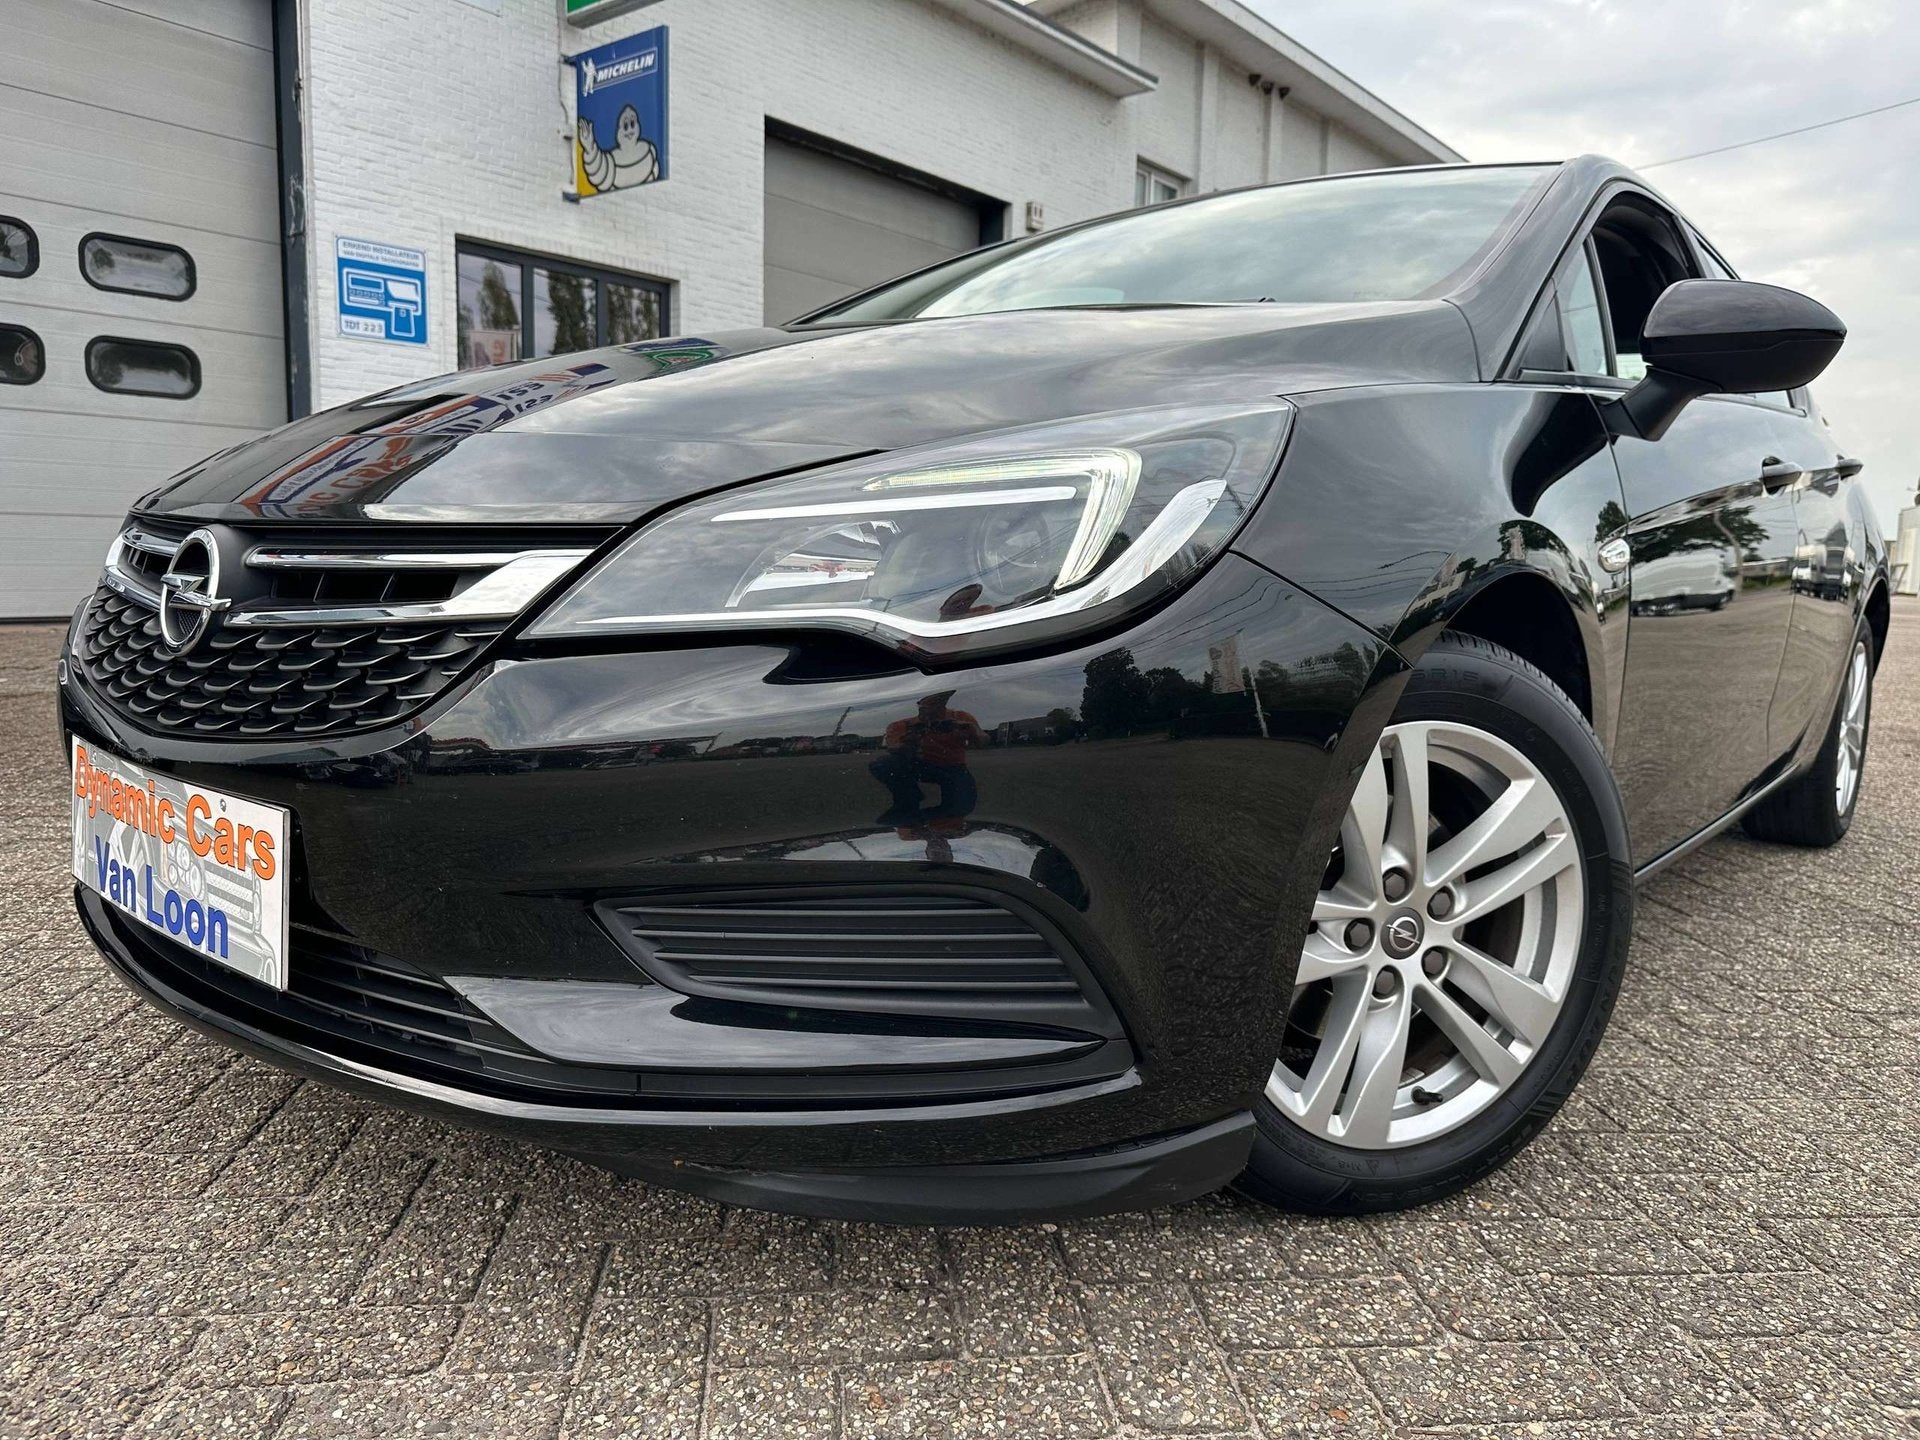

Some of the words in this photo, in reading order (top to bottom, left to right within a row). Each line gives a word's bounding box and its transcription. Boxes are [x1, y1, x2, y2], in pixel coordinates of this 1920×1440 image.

[597, 53, 655, 83] MICHELIN
[364, 322, 383, 334] 223
[76, 744, 176, 844] Dynamic
[186, 794, 276, 881] Cars
[95, 834, 137, 913] Van
[146, 865, 229, 960] Loon
